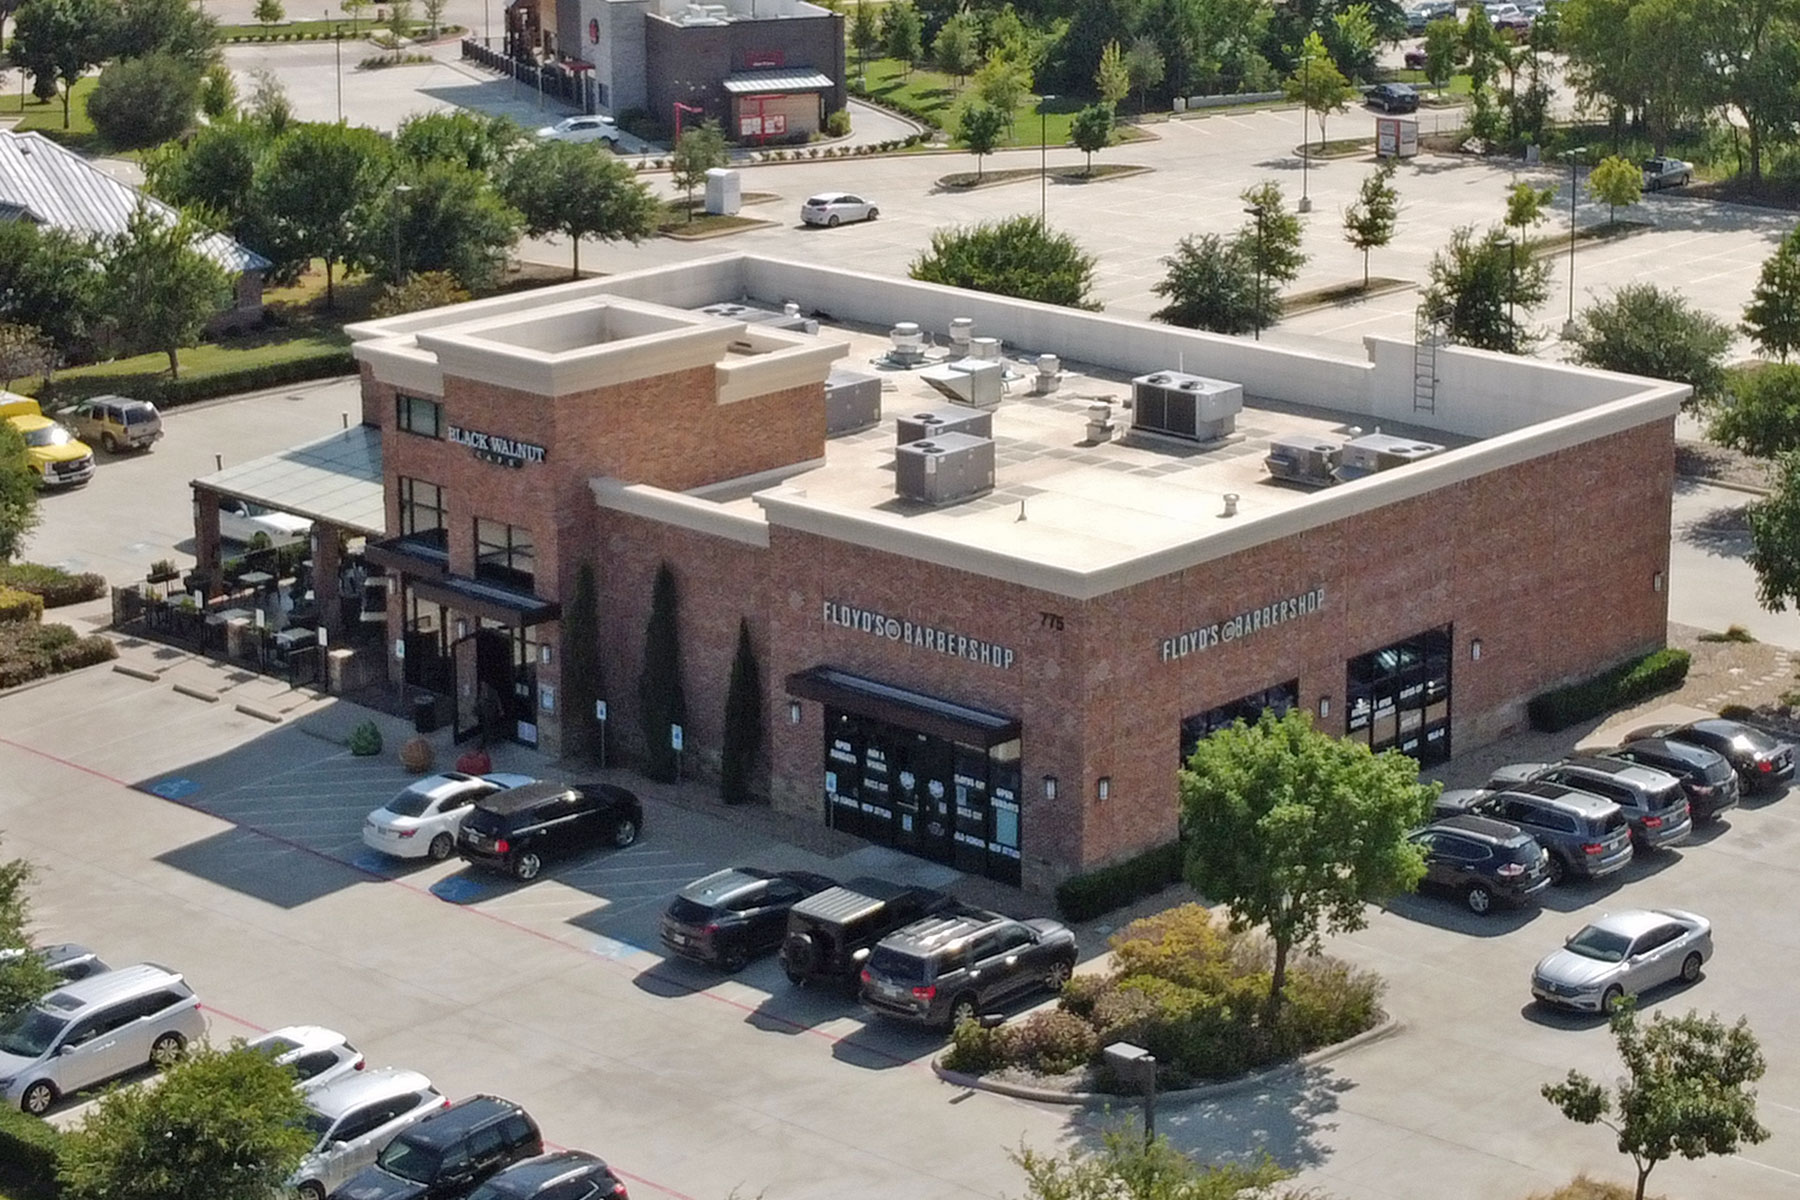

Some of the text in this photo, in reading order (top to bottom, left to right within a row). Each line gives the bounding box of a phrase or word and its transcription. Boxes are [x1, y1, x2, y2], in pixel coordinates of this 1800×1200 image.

[448, 426, 545, 463] BLACK WALNUT
[823, 602, 1014, 670] FLOYD'S BARBERSHOP
[1163, 588, 1325, 662] FLOYD'S BARBERSHOP
